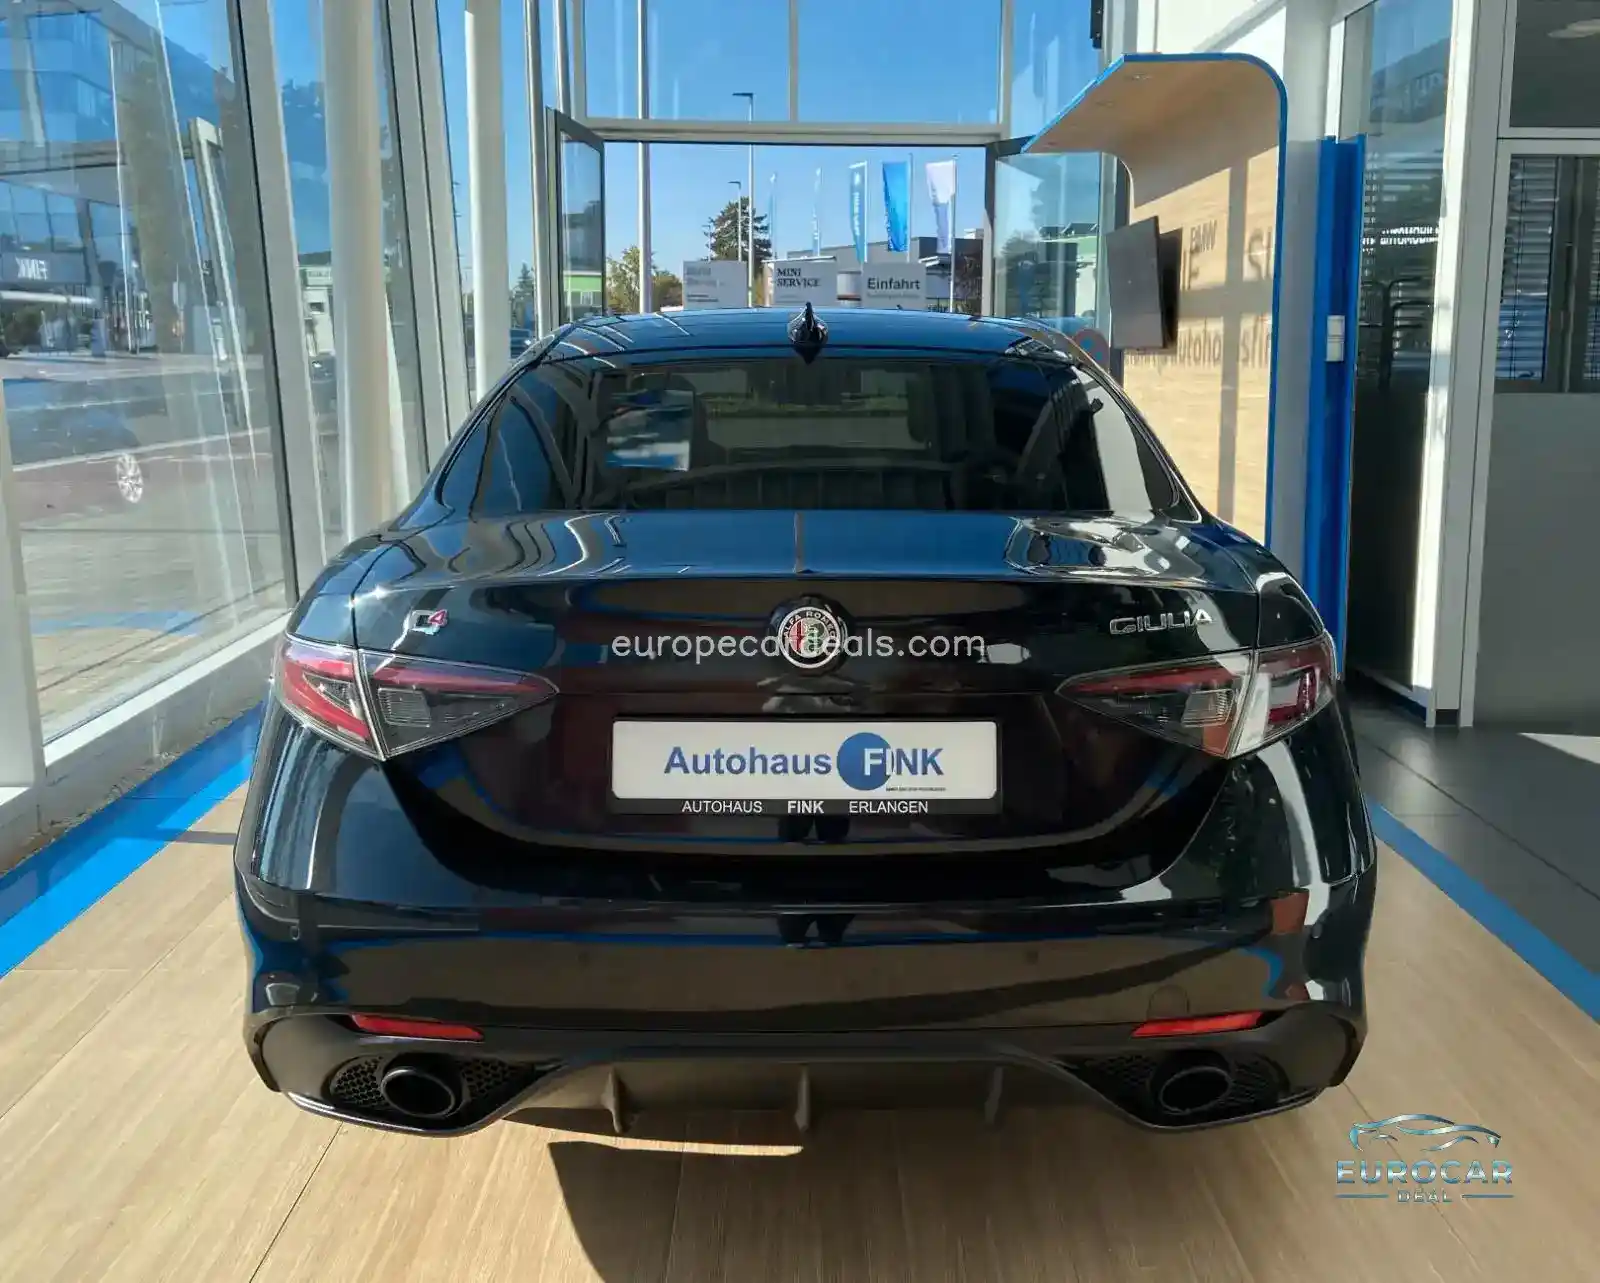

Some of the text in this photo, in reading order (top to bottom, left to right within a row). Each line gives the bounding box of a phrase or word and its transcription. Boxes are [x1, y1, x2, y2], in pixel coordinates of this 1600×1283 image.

[777, 267, 801, 276] MINI
[777, 277, 821, 287] SERVICE
[867, 276, 920, 289] Einfahrt
[783, 611, 836, 638] ALFA ROMEO
[1110, 608, 1212, 634] GIULIA
[663, 746, 944, 775] Autohaus FINK
[682, 800, 929, 814] AUTOHAUS FINK ERLANGEN
